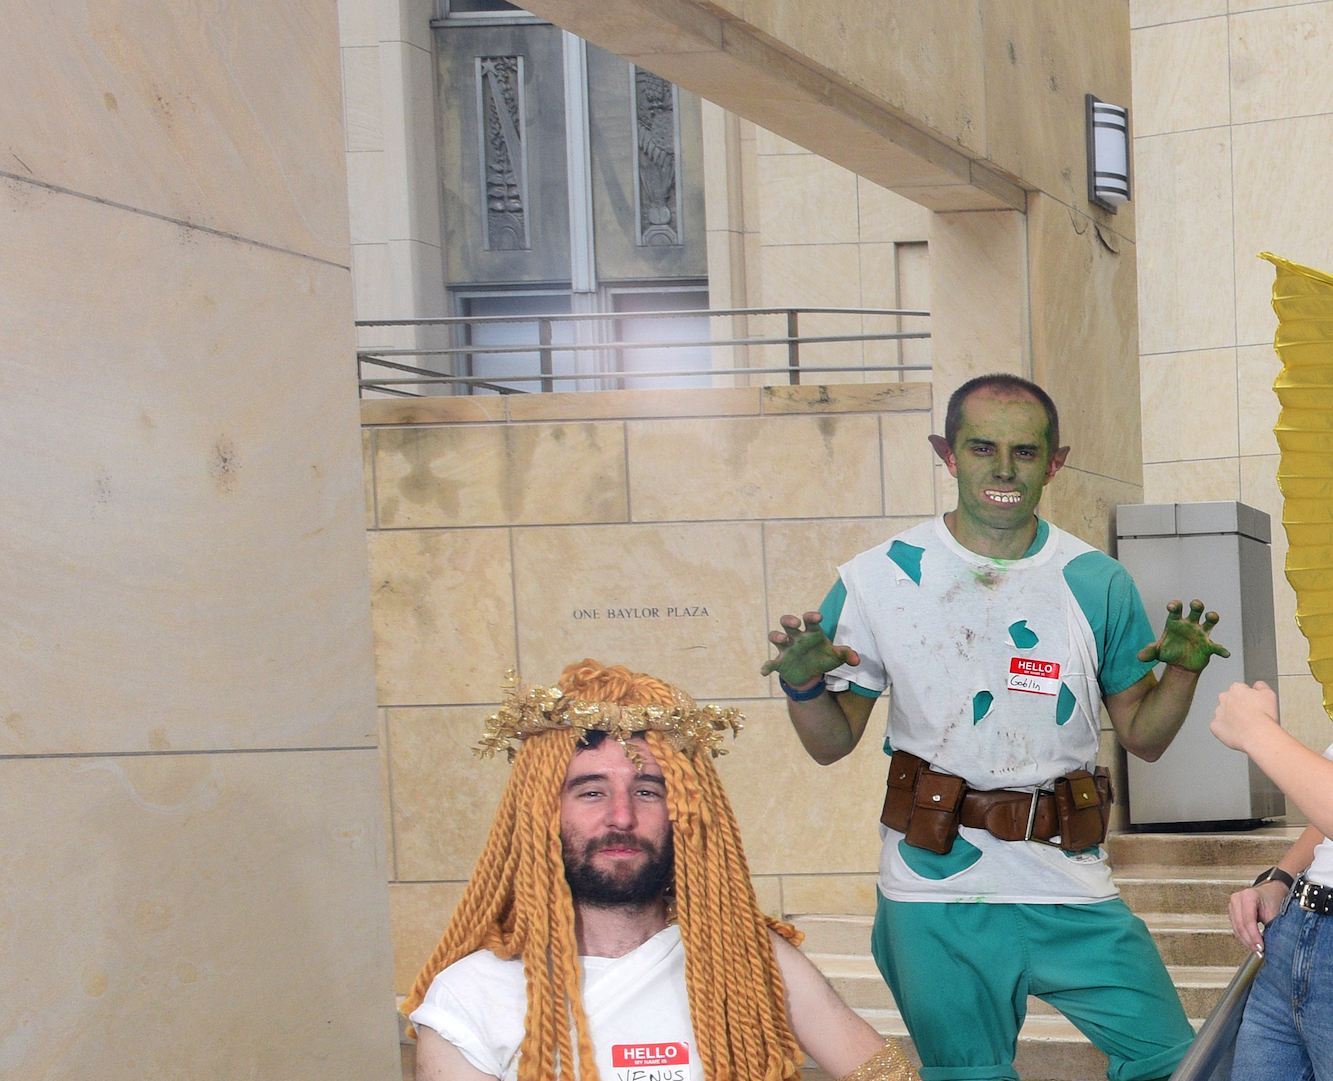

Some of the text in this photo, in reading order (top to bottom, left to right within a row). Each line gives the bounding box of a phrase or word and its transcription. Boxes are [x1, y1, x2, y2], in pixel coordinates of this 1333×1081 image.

[572, 606, 710, 620] ONE BAYLOR PLAZA
[1018, 661, 1053, 673] HELLO
[624, 1046, 677, 1060] HELLO
